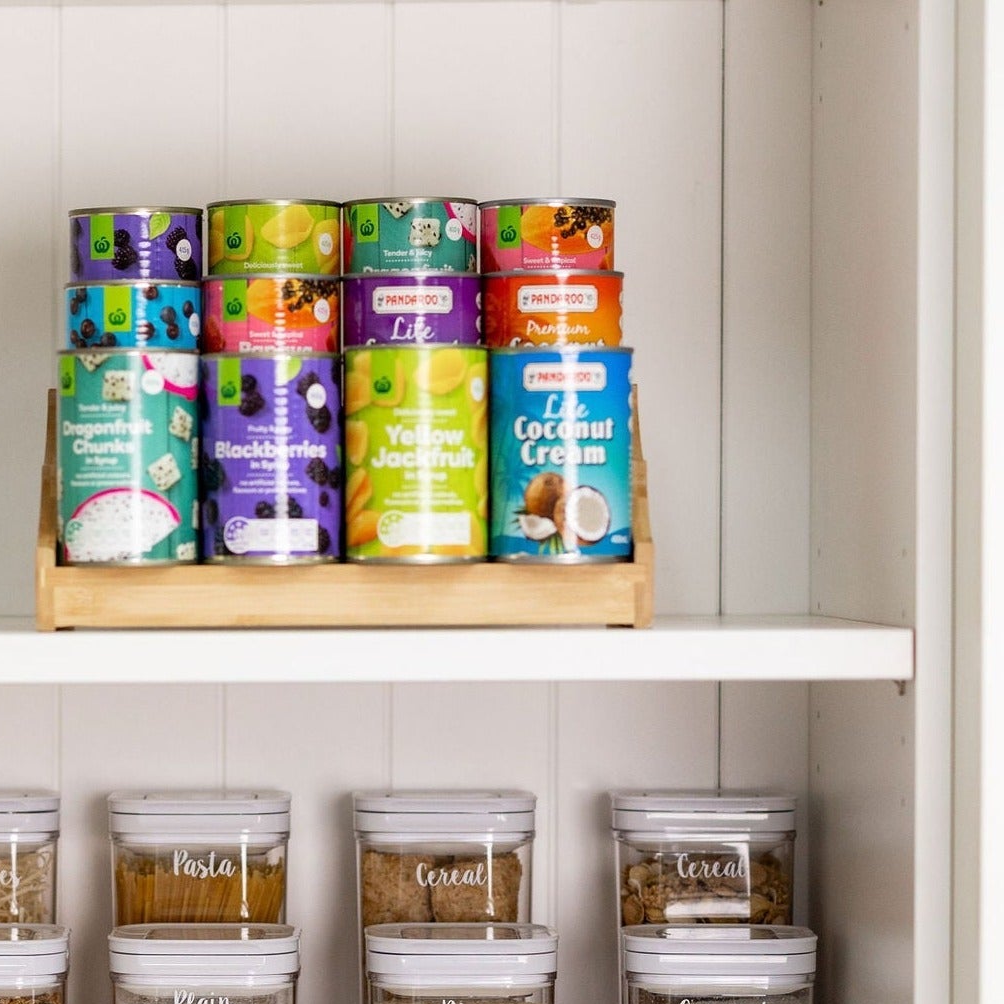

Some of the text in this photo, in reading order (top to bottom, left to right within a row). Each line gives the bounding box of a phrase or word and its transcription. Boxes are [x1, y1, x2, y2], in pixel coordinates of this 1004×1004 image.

[390, 316, 435, 341] Lite
[526, 319, 591, 336] Premium
[62, 418, 153, 439] Dragonfruit
[385, 425, 465, 446] Yellow
[514, 415, 615, 441] Coconut
[72, 438, 135, 455] Chunks
[214, 440, 327, 459] Blackberries
[371, 446, 475, 468] Jackfruit
[520, 439, 607, 465] Cream
[172, 850, 235, 879] Pasta
[415, 862, 489, 887] Cereal
[676, 853, 748, 880] Cereal
